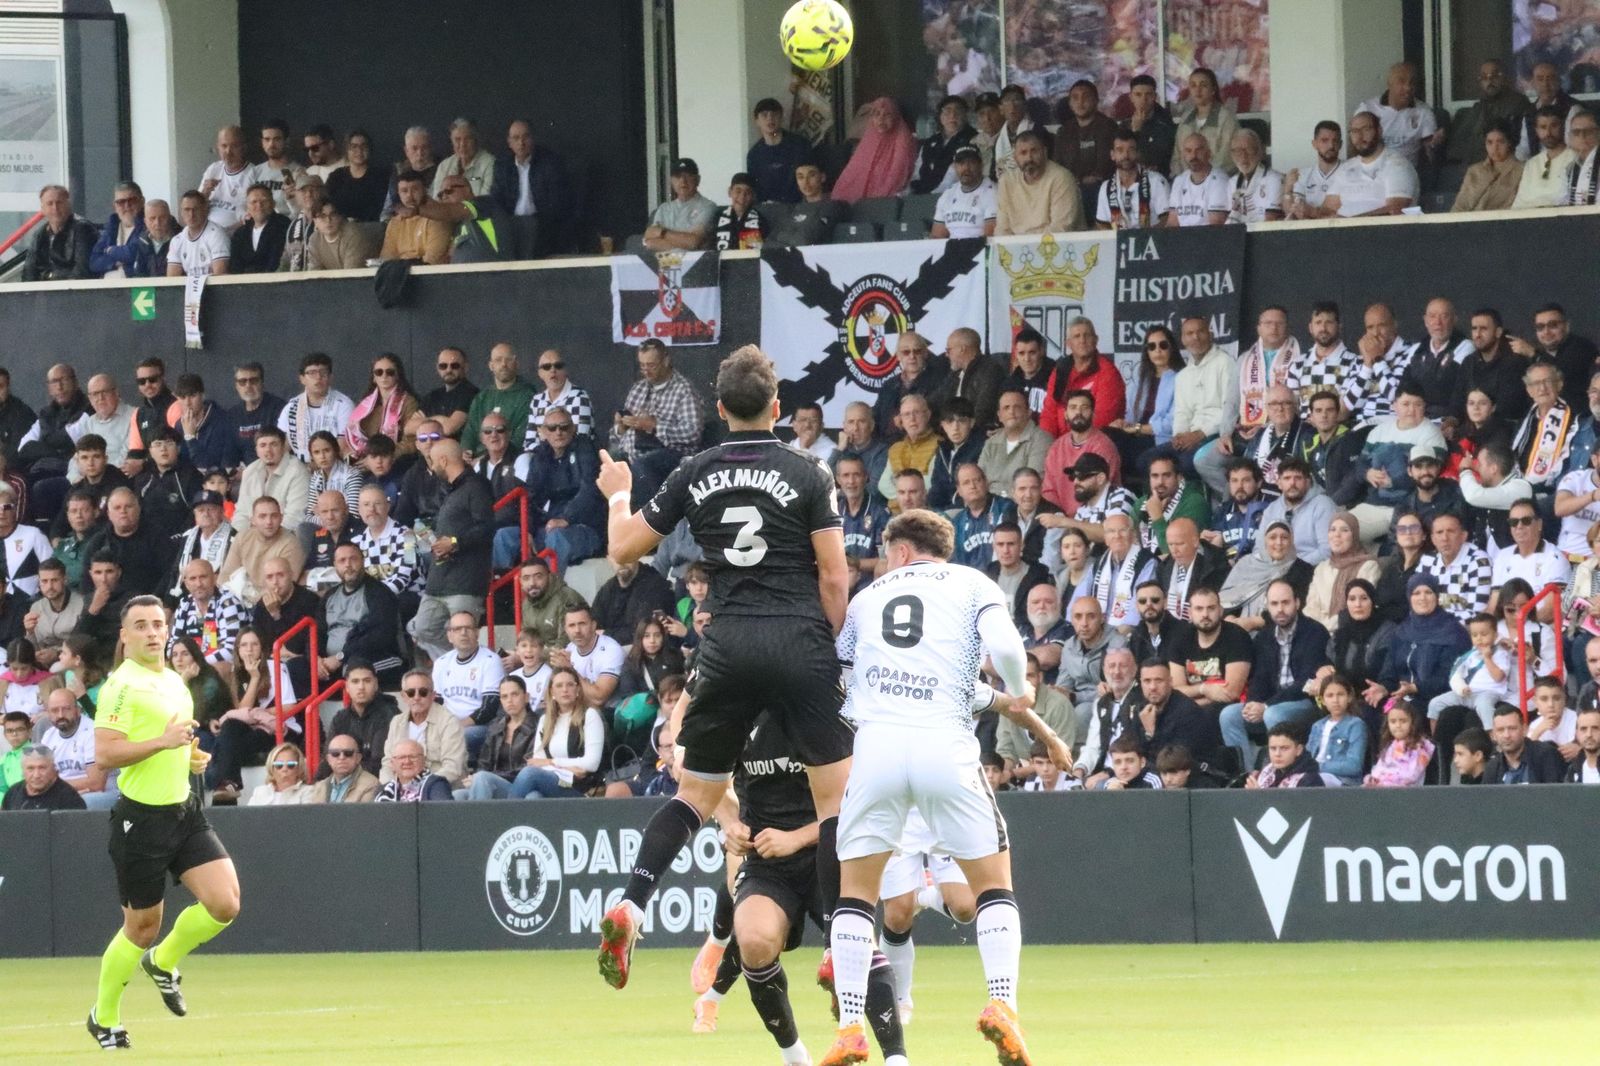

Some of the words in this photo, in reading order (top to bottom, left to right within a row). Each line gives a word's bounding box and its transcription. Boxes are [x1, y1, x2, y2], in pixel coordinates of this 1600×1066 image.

[946, 211, 977, 225] CEUTA
[872, 278, 894, 291] FANS
[892, 287, 911, 311] CLUB
[1118, 269, 1235, 303] HISTORIA
[721, 506, 768, 567] 3
[844, 533, 872, 549] EUTA
[880, 666, 939, 687] DARYSO
[443, 686, 478, 700] CEUTA
[879, 681, 934, 701] MOTOR
[494, 832, 523, 861] DARYSO
[525, 832, 553, 861] MOTOR
[633, 867, 655, 882] UDA
[1323, 844, 1567, 902] macron
[506, 913, 543, 929] CEUTA
[837, 933, 873, 944] CEUTA
[977, 926, 1009, 937] EUTA
